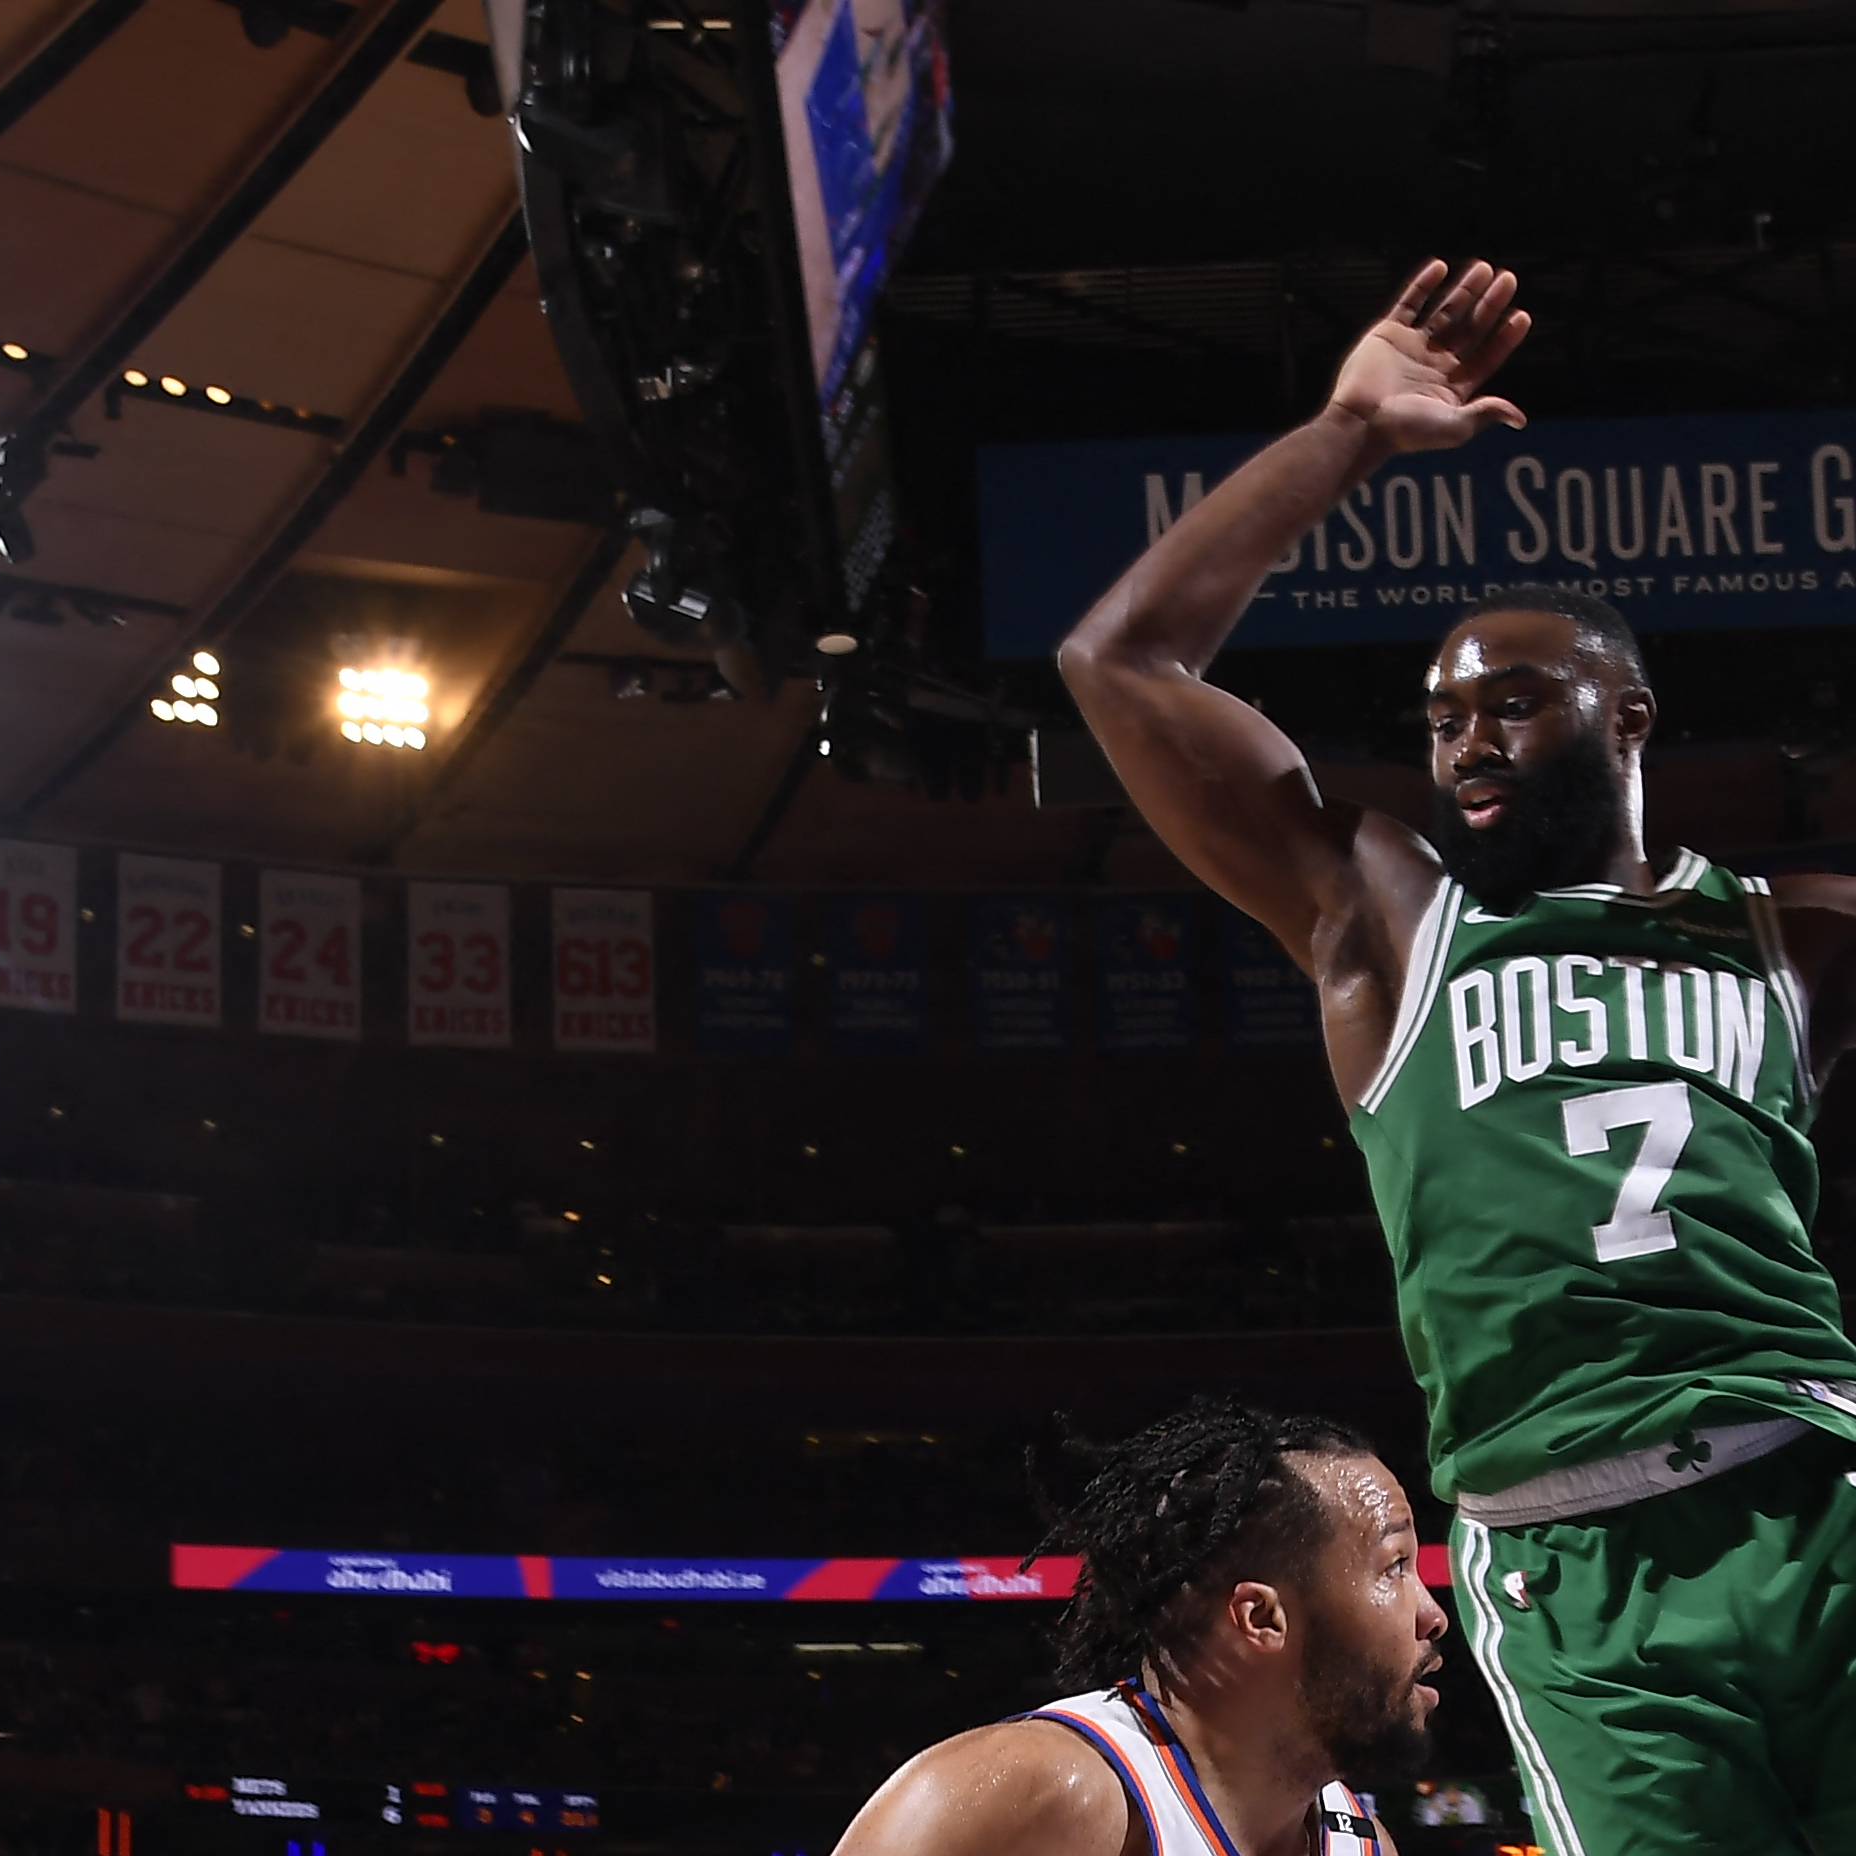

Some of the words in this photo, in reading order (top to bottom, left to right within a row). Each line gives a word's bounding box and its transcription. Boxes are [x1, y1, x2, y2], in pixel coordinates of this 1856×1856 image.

[1505, 455, 1784, 570] SQUARE
[1293, 589, 1370, 610] THE
[1672, 571, 1819, 594] FAMOUS
[125, 904, 213, 974] 22
[268, 918, 353, 988] 24
[415, 930, 503, 995] 33
[556, 936, 653, 999] 613
[121, 979, 216, 1015] KNICKS
[264, 993, 357, 1028] KNICKS
[412, 1004, 506, 1035] KNICKS
[559, 1010, 652, 1040] KNICKS
[1448, 954, 1767, 1111] BOSTON
[1560, 1080, 1695, 1264] 7
[1335, 1812, 1354, 1833] 12
